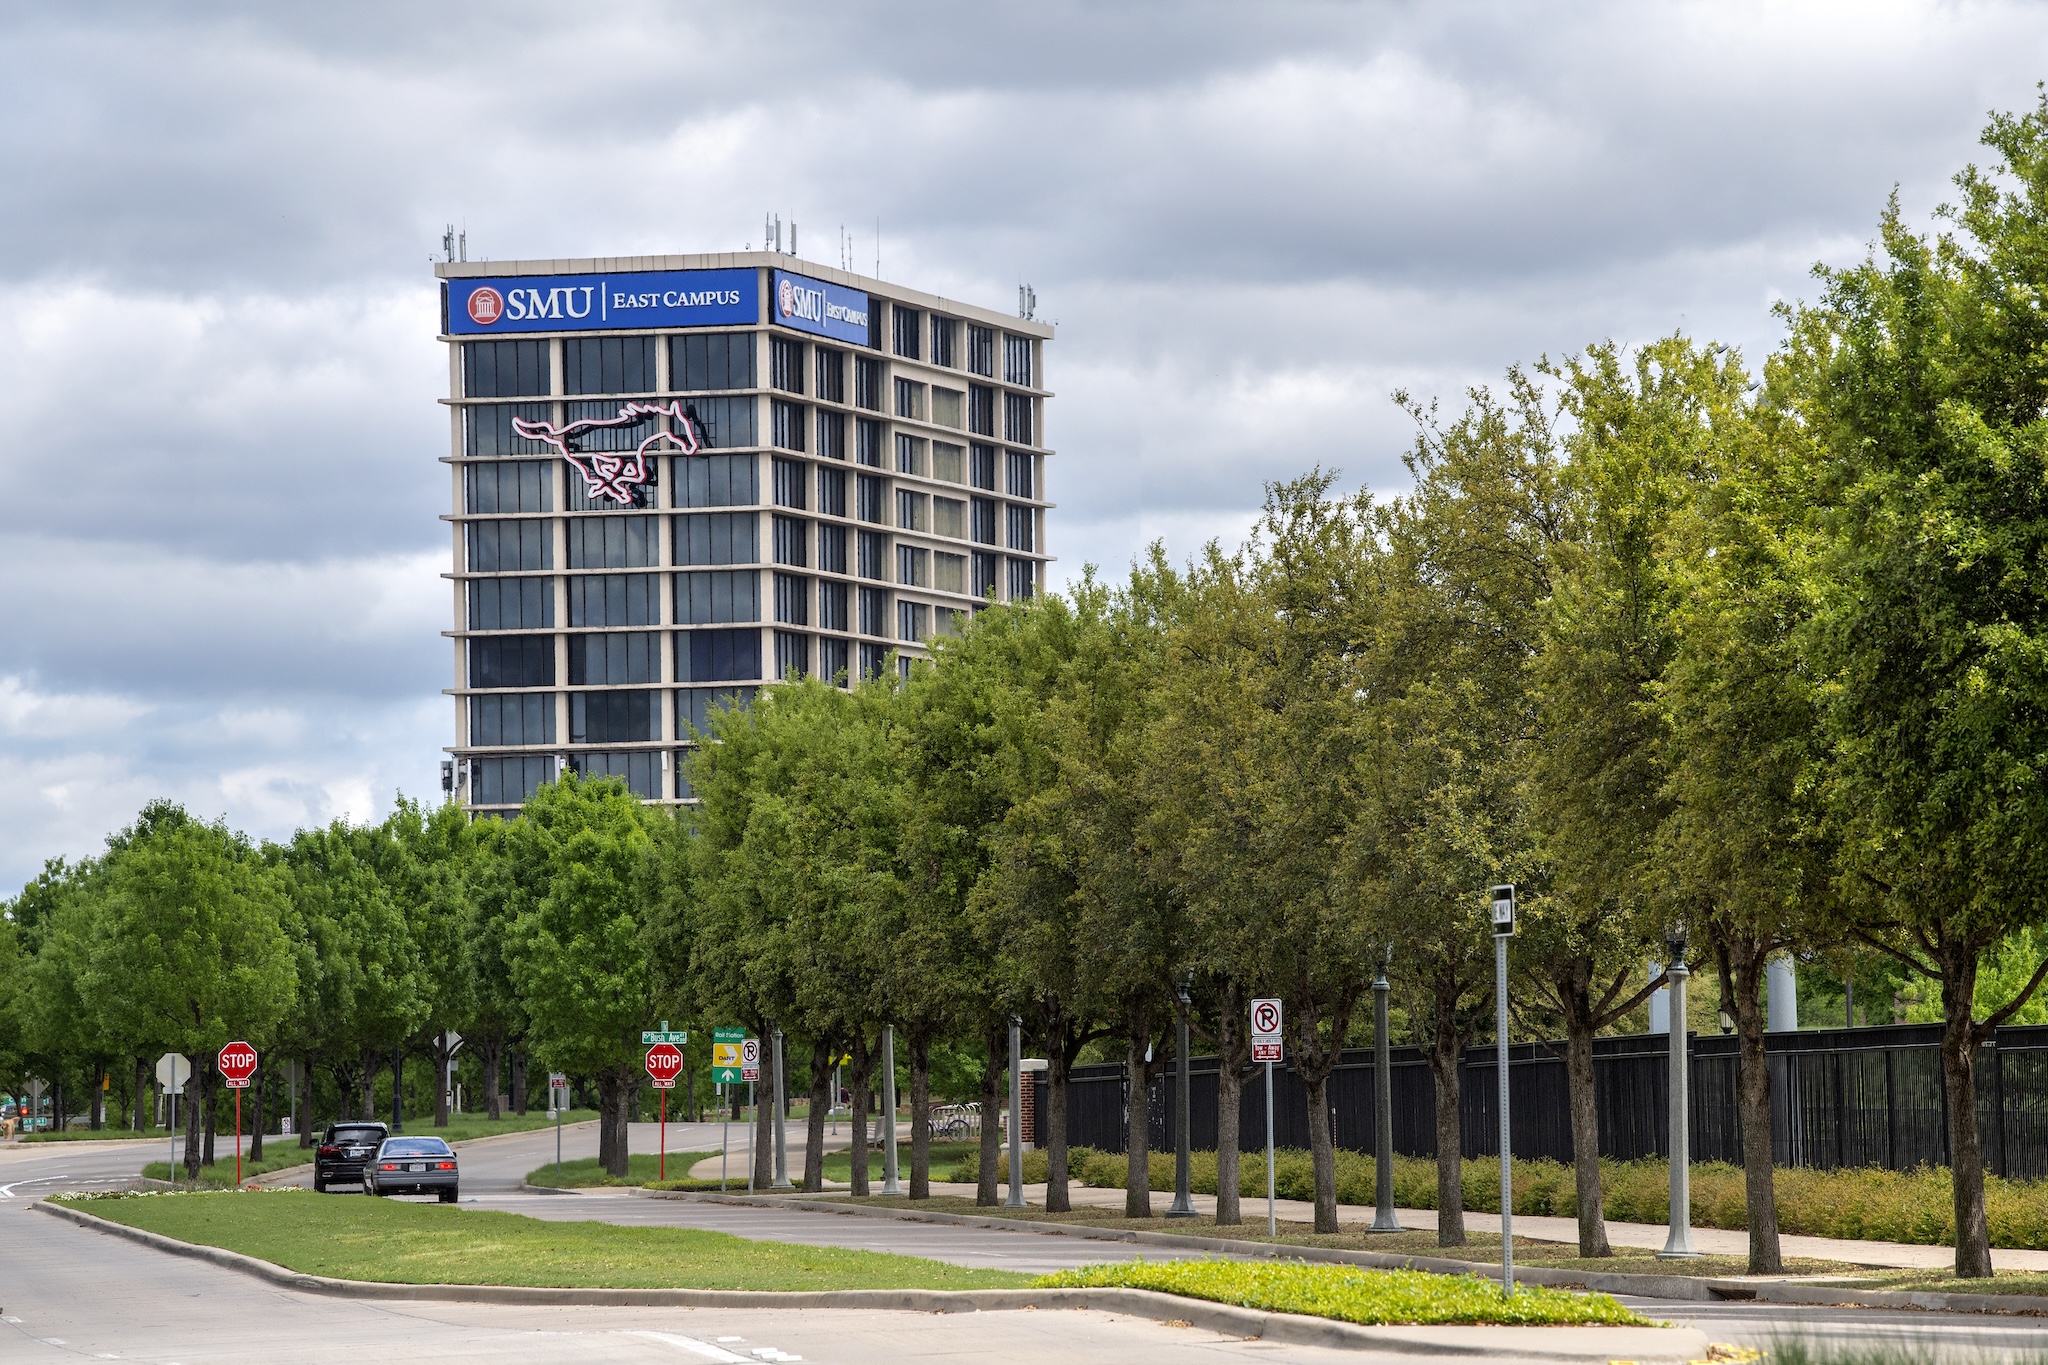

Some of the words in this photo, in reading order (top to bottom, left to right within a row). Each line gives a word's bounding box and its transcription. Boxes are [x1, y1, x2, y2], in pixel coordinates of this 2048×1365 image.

[506, 287, 595, 320] SMU
[613, 293, 660, 309] EAST
[663, 290, 740, 307] CAMPUS
[793, 285, 822, 323] SMU
[651, 1032, 666, 1042] Bush
[669, 1032, 680, 1042] Ave
[221, 1053, 255, 1068] STOP
[649, 1054, 680, 1069] STOP
